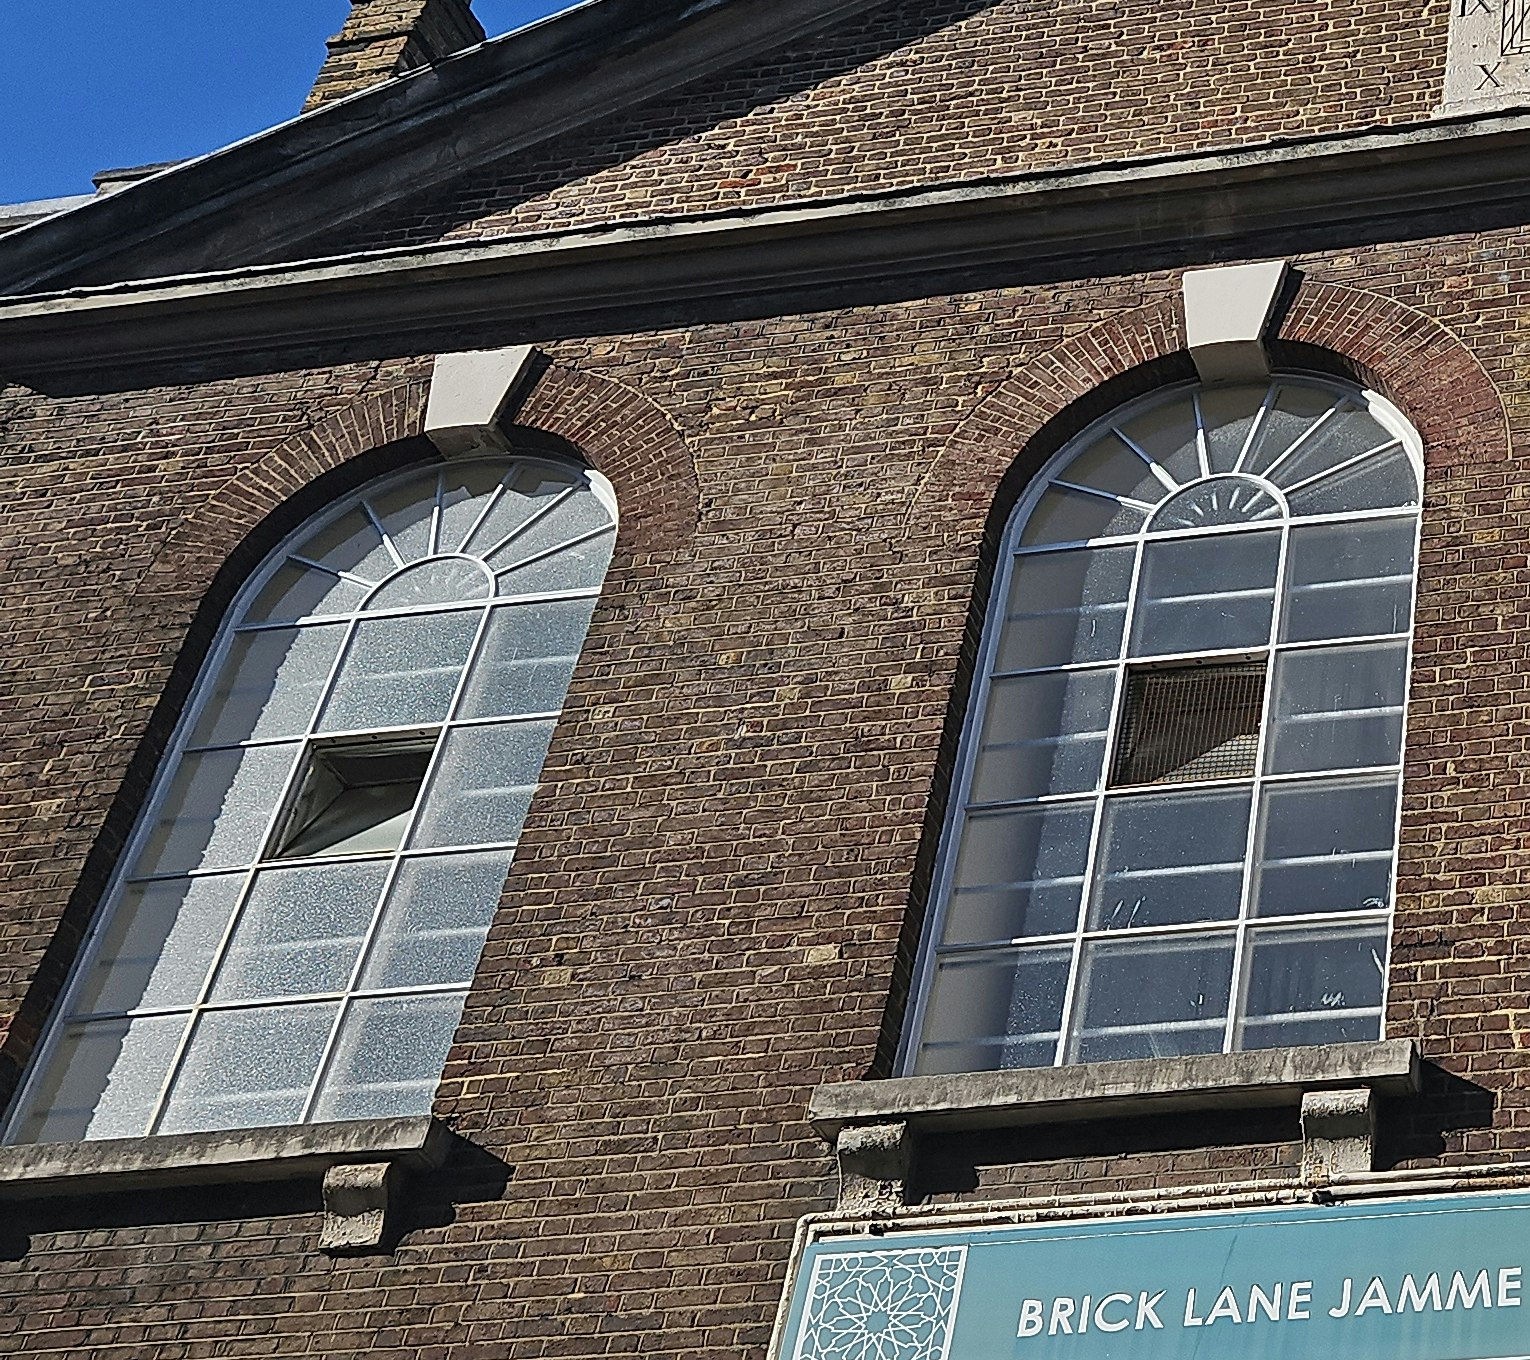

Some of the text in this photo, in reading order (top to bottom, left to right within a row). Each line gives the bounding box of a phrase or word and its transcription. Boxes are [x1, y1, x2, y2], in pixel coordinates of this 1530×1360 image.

[1474, 61, 1505, 91] X
[1016, 1288, 1168, 1338] BRICK
[1182, 1281, 1314, 1328] LANE
[1327, 1266, 1522, 1319] JAMME
